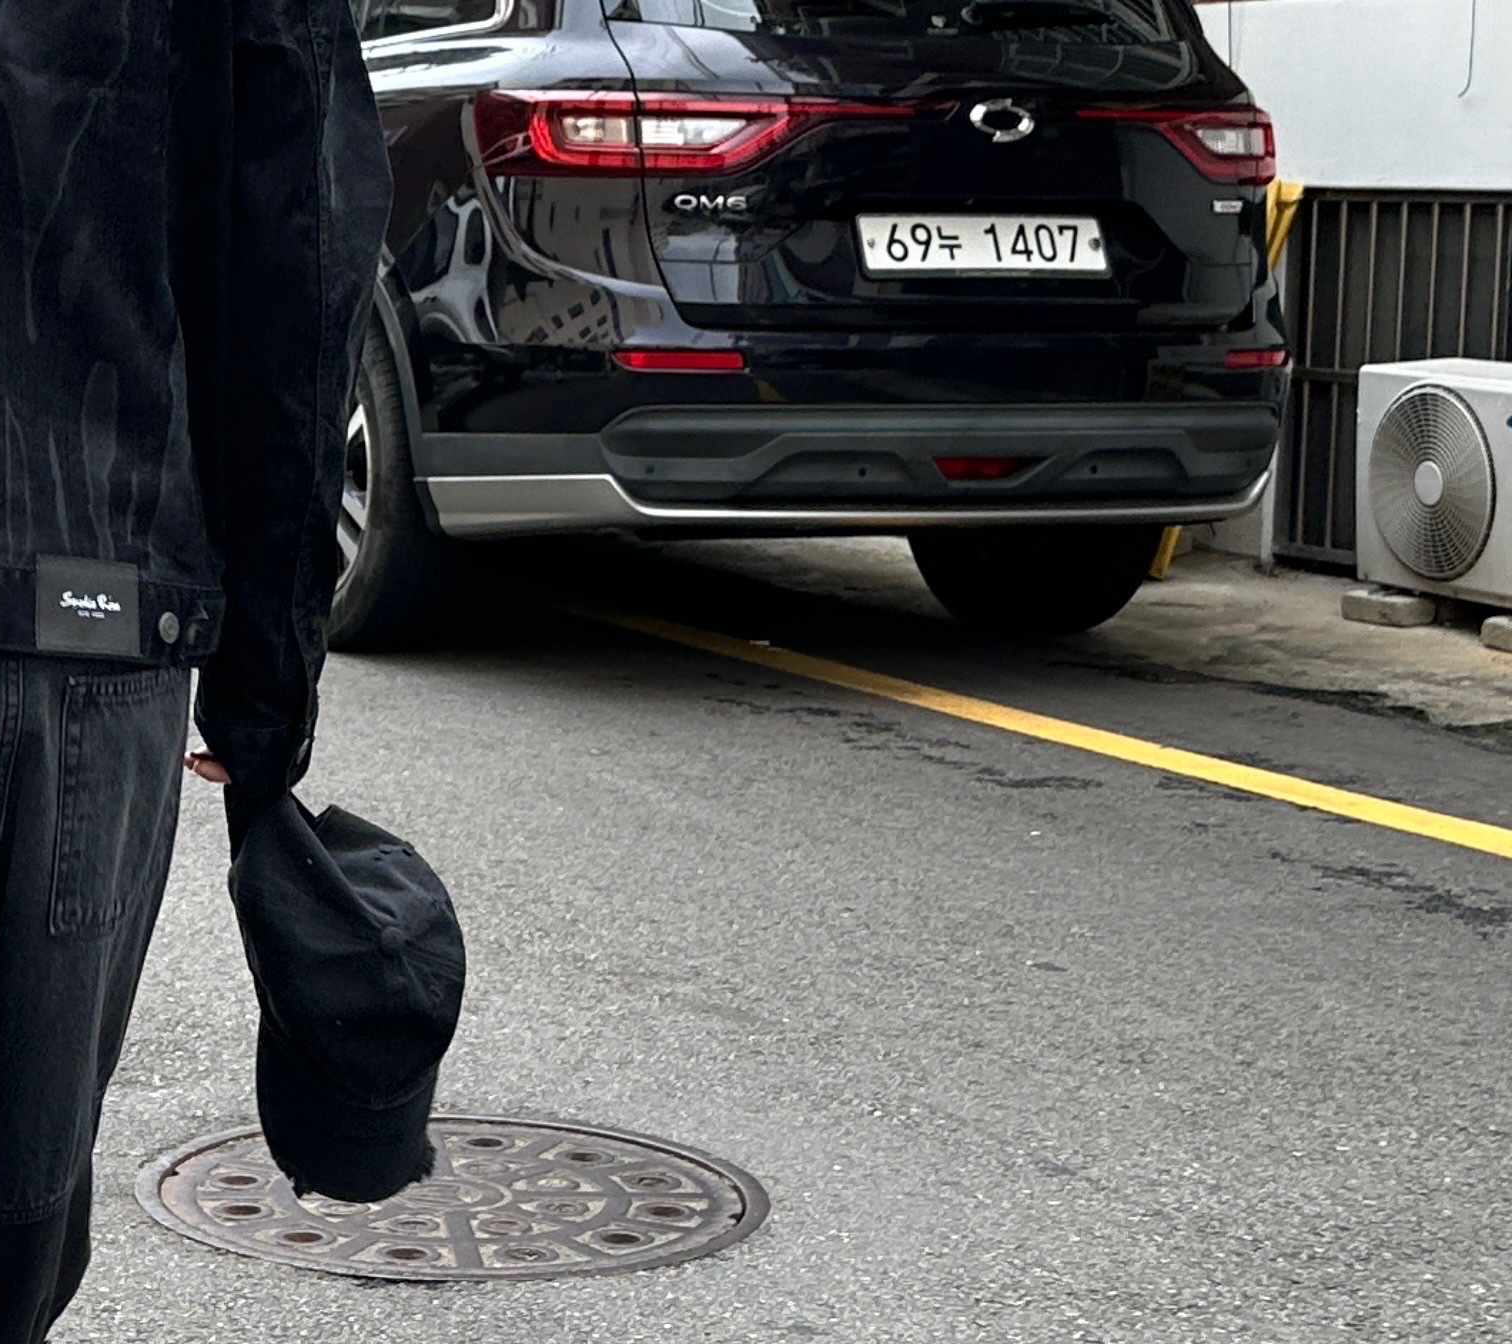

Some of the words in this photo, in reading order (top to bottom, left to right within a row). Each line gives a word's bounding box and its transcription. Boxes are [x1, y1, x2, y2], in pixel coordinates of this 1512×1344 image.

[674, 194, 747, 211] QM6
[886, 223, 962, 262] 69누
[984, 224, 1079, 263] 1407
